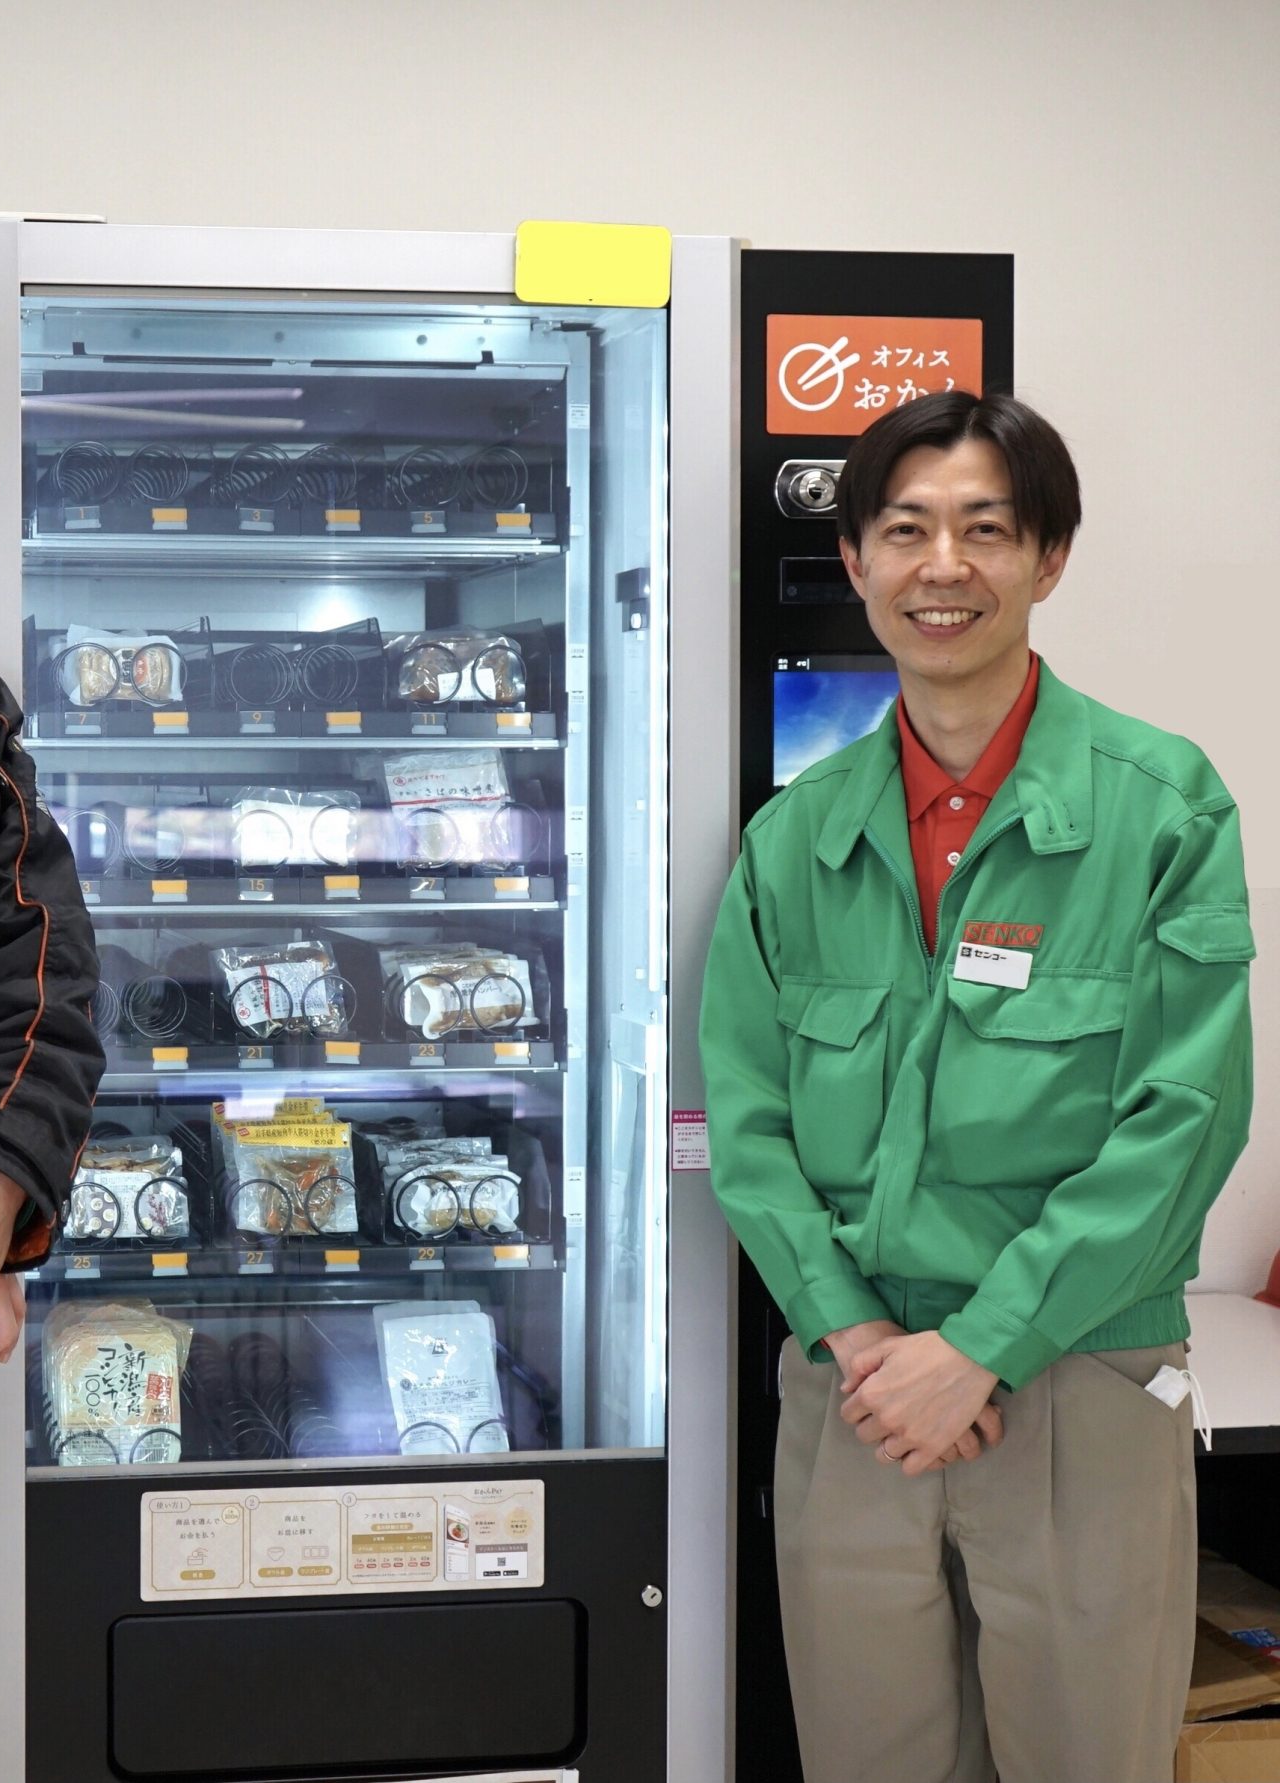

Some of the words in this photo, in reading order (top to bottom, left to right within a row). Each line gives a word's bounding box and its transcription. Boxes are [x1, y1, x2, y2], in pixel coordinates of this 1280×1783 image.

[871, 345, 950, 369] オフィス
[853, 377, 955, 410] おか
[252, 510, 261, 521] 3
[424, 512, 433, 523] 5
[79, 713, 87, 725] 7
[252, 712, 262, 724] 9
[423, 713, 436, 725] 11
[249, 879, 265, 891] 15
[964, 923, 1039, 944] SENKO
[974, 949, 1007, 961] センコー
[247, 1047, 262, 1058] 21
[419, 1045, 436, 1056] 23
[247, 1253, 264, 1264] 27
[419, 1248, 435, 1260] 29
[73, 1257, 91, 1269] 25
